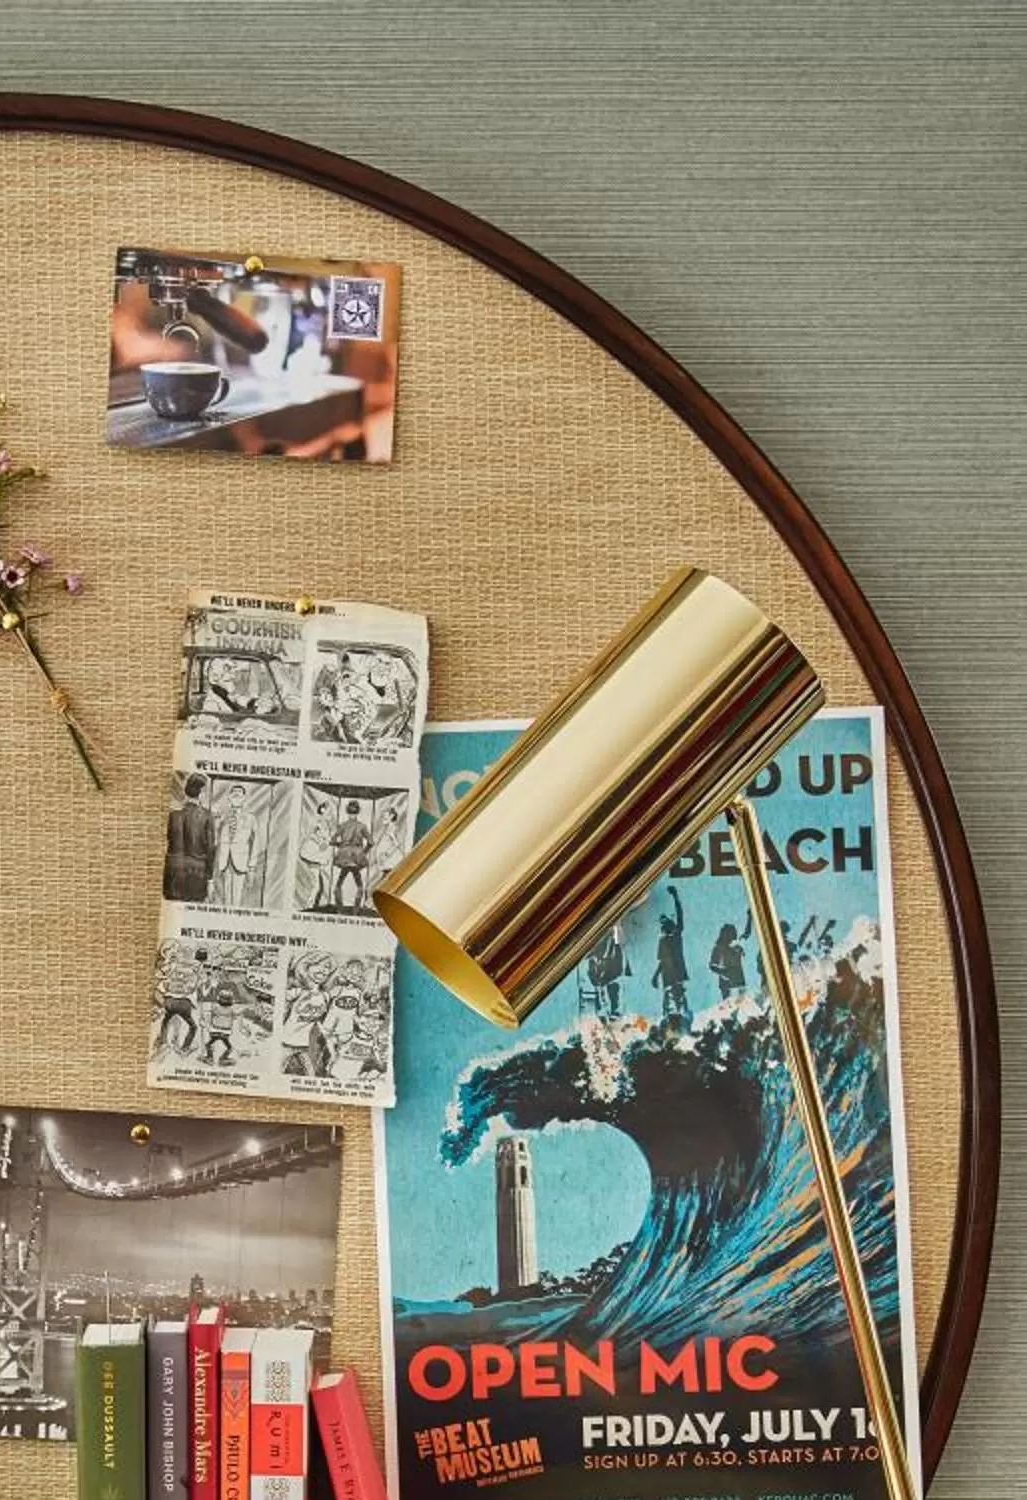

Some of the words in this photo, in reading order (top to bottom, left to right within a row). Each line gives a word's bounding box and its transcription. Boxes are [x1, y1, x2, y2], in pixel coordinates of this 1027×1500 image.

[194, 760, 217, 770] WE'LL
[222, 762, 248, 773] NEVER
[798, 753, 873, 797] UP
[180, 927, 205, 939] WE'LL
[207, 929, 233, 941] NEVER
[234, 930, 287, 945] UNDERSTAND
[162, 1357, 174, 1395] GARY
[408, 1338, 617, 1401] OPEN
[640, 1335, 780, 1395] MIC
[194, 1346, 213, 1436] Alexandre
[104, 1395, 115, 1469] DUSSAULT
[162, 1400, 174, 1437] JOHN
[430, 1418, 493, 1456] BEAT
[582, 1411, 730, 1448] FRIDAY,
[741, 1408, 841, 1443] JULY
[194, 1440, 212, 1484] Mars
[226, 1435, 240, 1482] PAULO
[414, 1428, 432, 1459] THE
[435, 1437, 542, 1484] MUSEUM
[583, 1454, 628, 1470] SIGN
[633, 1452, 658, 1468] UP
[665, 1451, 688, 1468] AT
[748, 1448, 814, 1466] STARTS
[822, 1448, 844, 1462] AT
[162, 1441, 174, 1492] BISHOP
